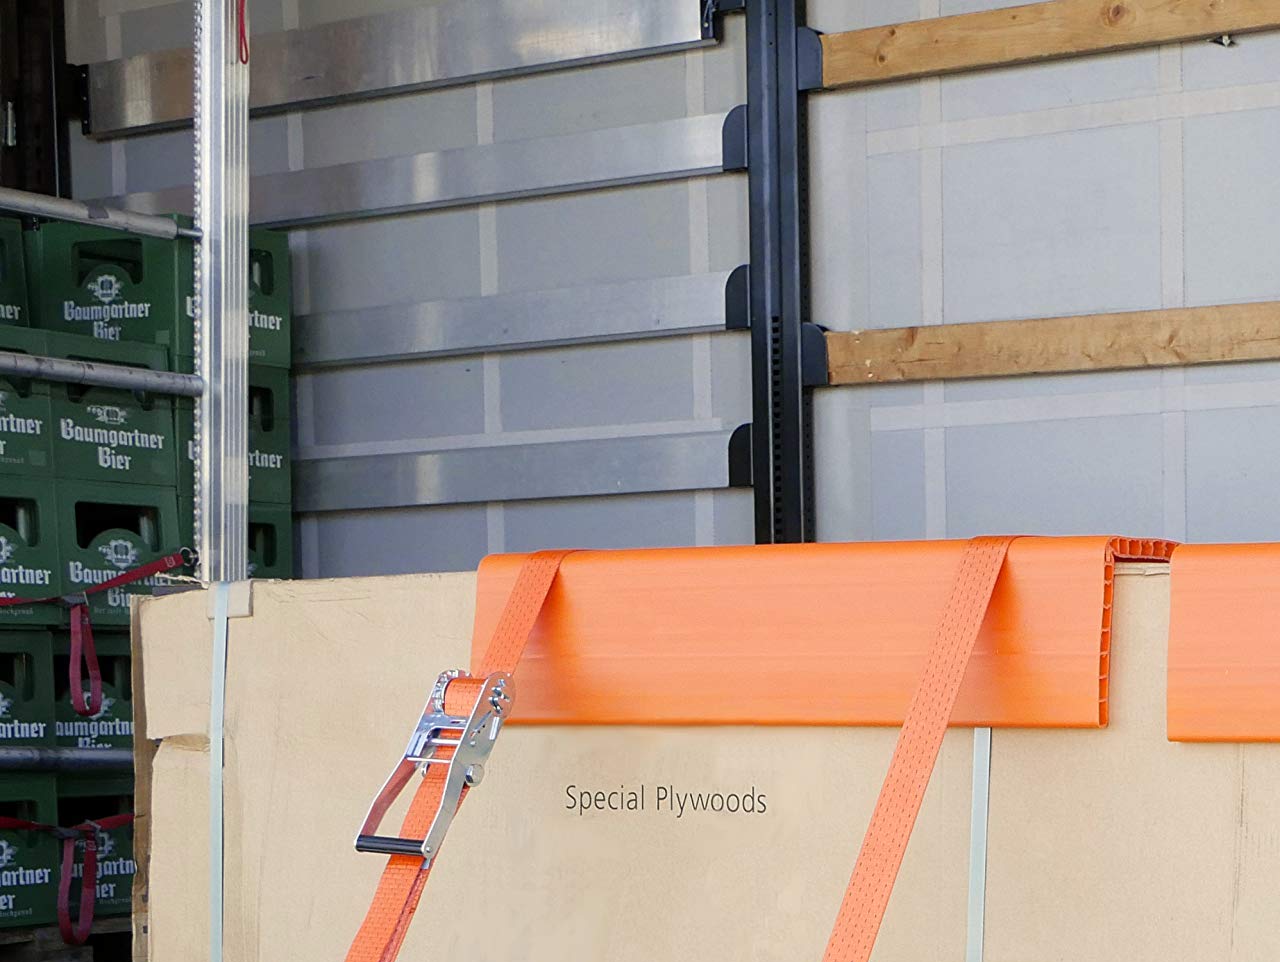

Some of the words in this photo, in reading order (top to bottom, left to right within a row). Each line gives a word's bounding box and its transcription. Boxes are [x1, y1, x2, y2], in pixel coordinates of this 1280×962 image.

[63, 300, 151, 321] Baumgartner
[93, 321, 121, 341] Bier
[60, 418, 164, 449] Baumgartner
[98, 446, 131, 470] Bier
[0, 565, 51, 585] artner
[0, 719, 46, 738] artner
[565, 784, 645, 817] Special
[656, 785, 767, 818] Plywoods
[0, 866, 51, 887] artner
